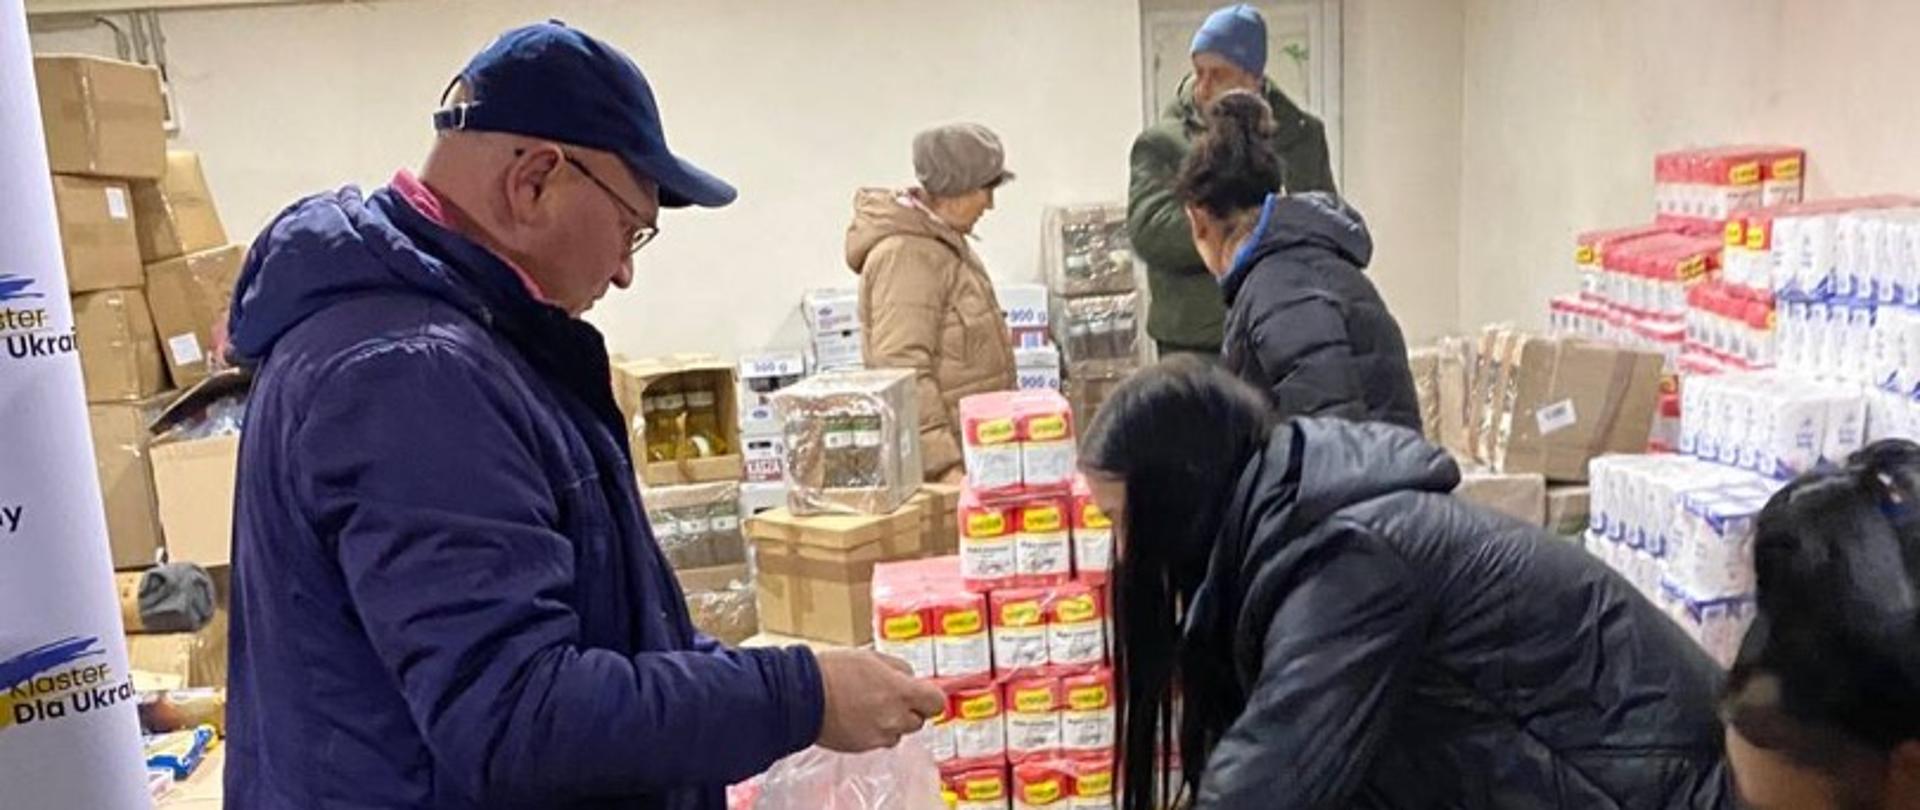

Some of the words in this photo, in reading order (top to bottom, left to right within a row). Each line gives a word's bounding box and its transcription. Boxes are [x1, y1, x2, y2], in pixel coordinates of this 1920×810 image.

[0, 506, 22, 532] y
[10, 663, 110, 698] Klaster
[14, 699, 65, 724] Dla
